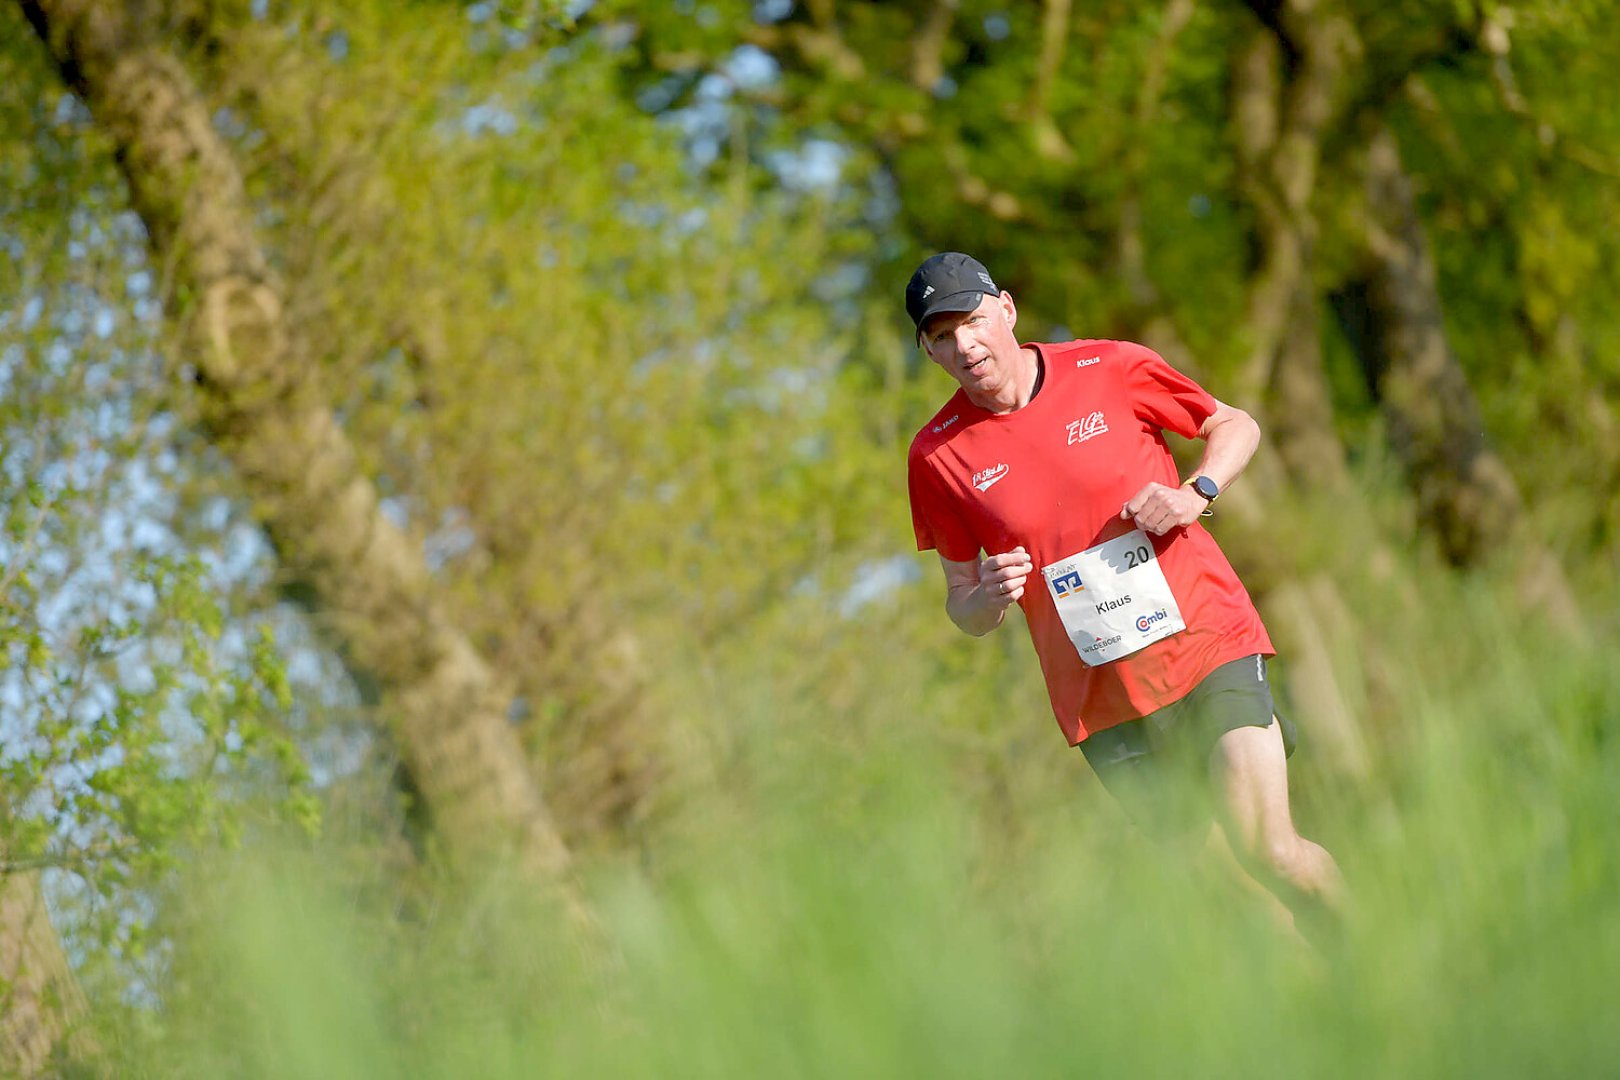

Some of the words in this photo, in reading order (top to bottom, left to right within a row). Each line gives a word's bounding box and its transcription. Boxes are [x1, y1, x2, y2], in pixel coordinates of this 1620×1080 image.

[1076, 356, 1101, 368] Klaus
[1124, 546, 1149, 569] 20
[1095, 594, 1132, 615] Klaus
[1135, 608, 1168, 632] Combi
[1082, 635, 1122, 653] WILDEBOER
